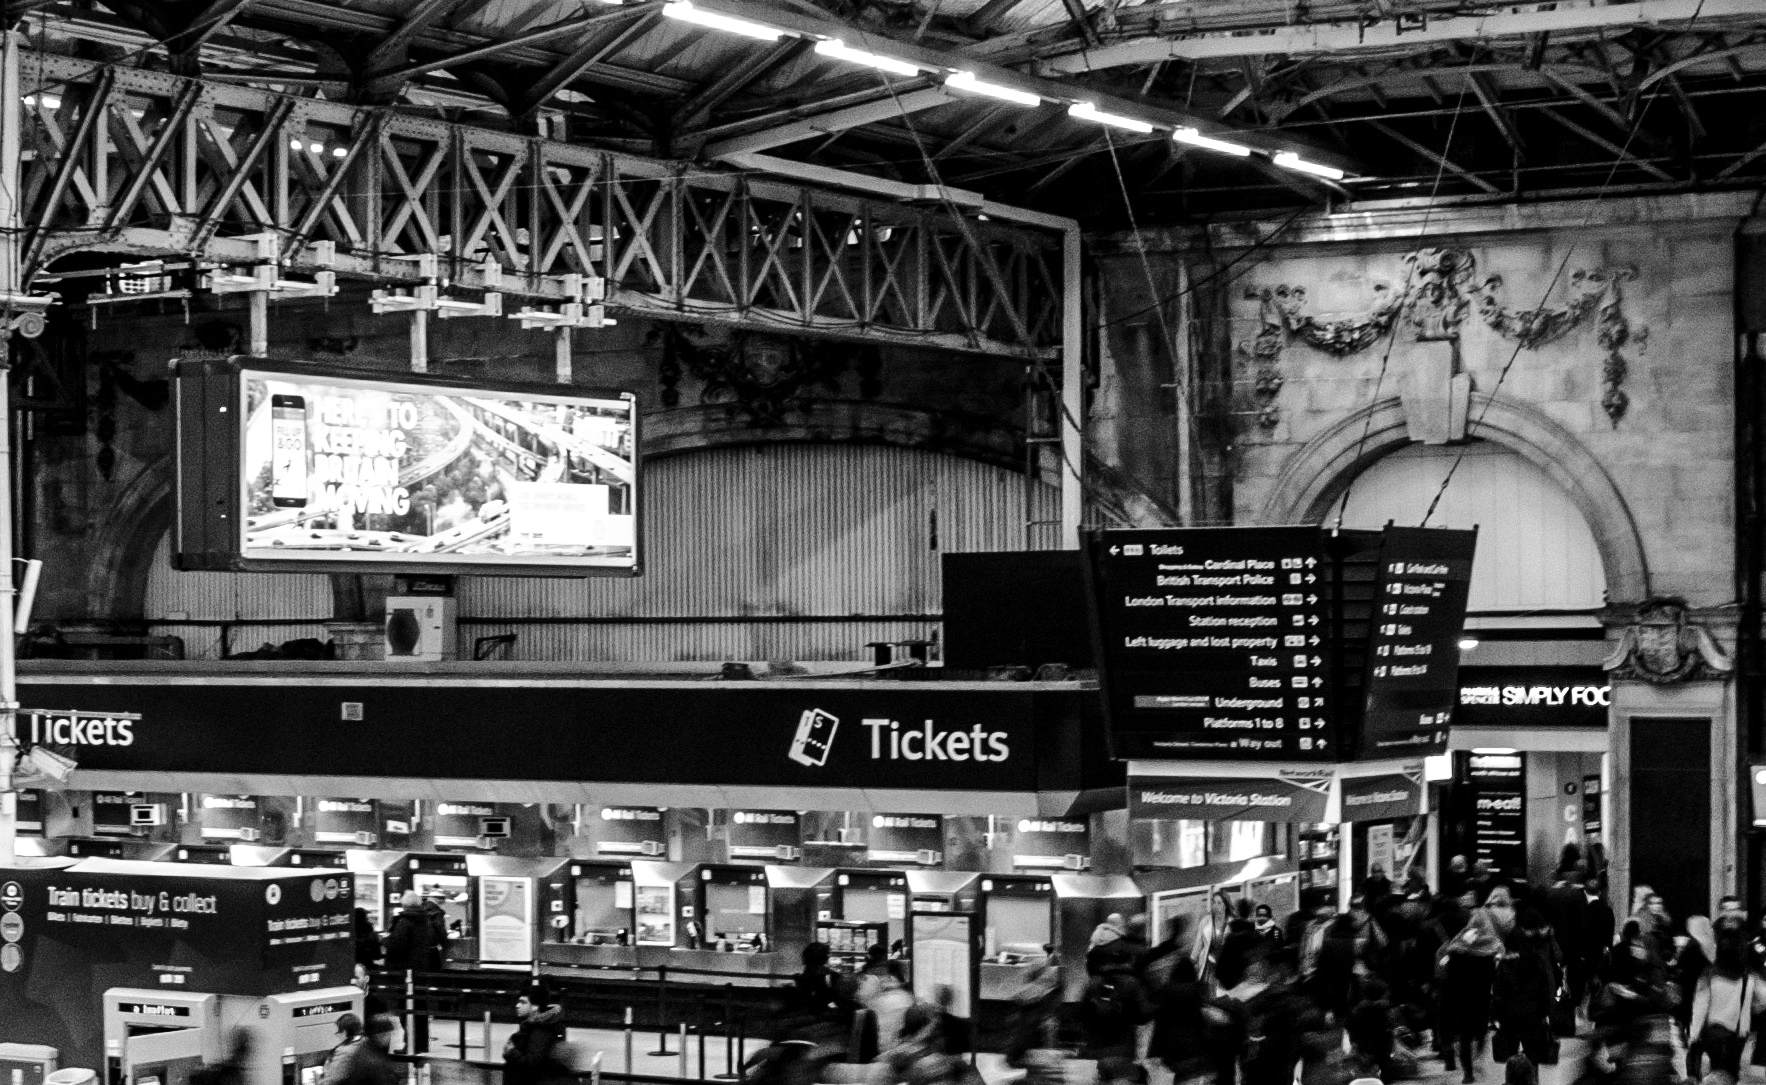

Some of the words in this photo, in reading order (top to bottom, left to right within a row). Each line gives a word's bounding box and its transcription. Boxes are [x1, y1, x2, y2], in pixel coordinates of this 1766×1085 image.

[388, 402, 418, 429] TO
[314, 424, 407, 457] KEEPING
[315, 484, 410, 516] MOVING
[1149, 544, 1184, 555] Toilets
[1204, 559, 1245, 570] Cardinal
[1247, 559, 1275, 570] Place
[1157, 575, 1190, 586] British
[1191, 574, 1241, 587] Transport
[1243, 574, 1275, 585] Police
[1125, 596, 1164, 606] London
[1165, 595, 1214, 607] Transport
[1216, 595, 1276, 605] information
[1189, 615, 1227, 626] Station
[1228, 616, 1278, 627] reception
[1125, 636, 1147, 647] Left
[1147, 636, 1188, 649] luggage
[1189, 636, 1209, 647] and
[1210, 636, 1230, 647] lost
[1232, 637, 1278, 649] property
[1250, 655, 1277, 666] Taxis
[1249, 676, 1281, 687] Buses
[1502, 686, 1569, 705] SIMPLY
[1215, 697, 1283, 710] Underground
[1203, 717, 1254, 729] Platforms
[1255, 717, 1261, 728] 1
[1261, 718, 1273, 728] to
[1274, 717, 1284, 729] 8
[861, 718, 1010, 762] Tickets
[1238, 738, 1262, 750] Way
[1263, 739, 1282, 749] out
[1141, 791, 1190, 804] Welcome
[1190, 793, 1204, 804] to
[1204, 793, 1249, 805] Victoria
[1249, 793, 1292, 806] Station
[47, 886, 80, 906] Train
[82, 887, 129, 909] tickets
[131, 890, 156, 915] buy
[159, 891, 170, 911] &
[173, 893, 218, 914] collect
